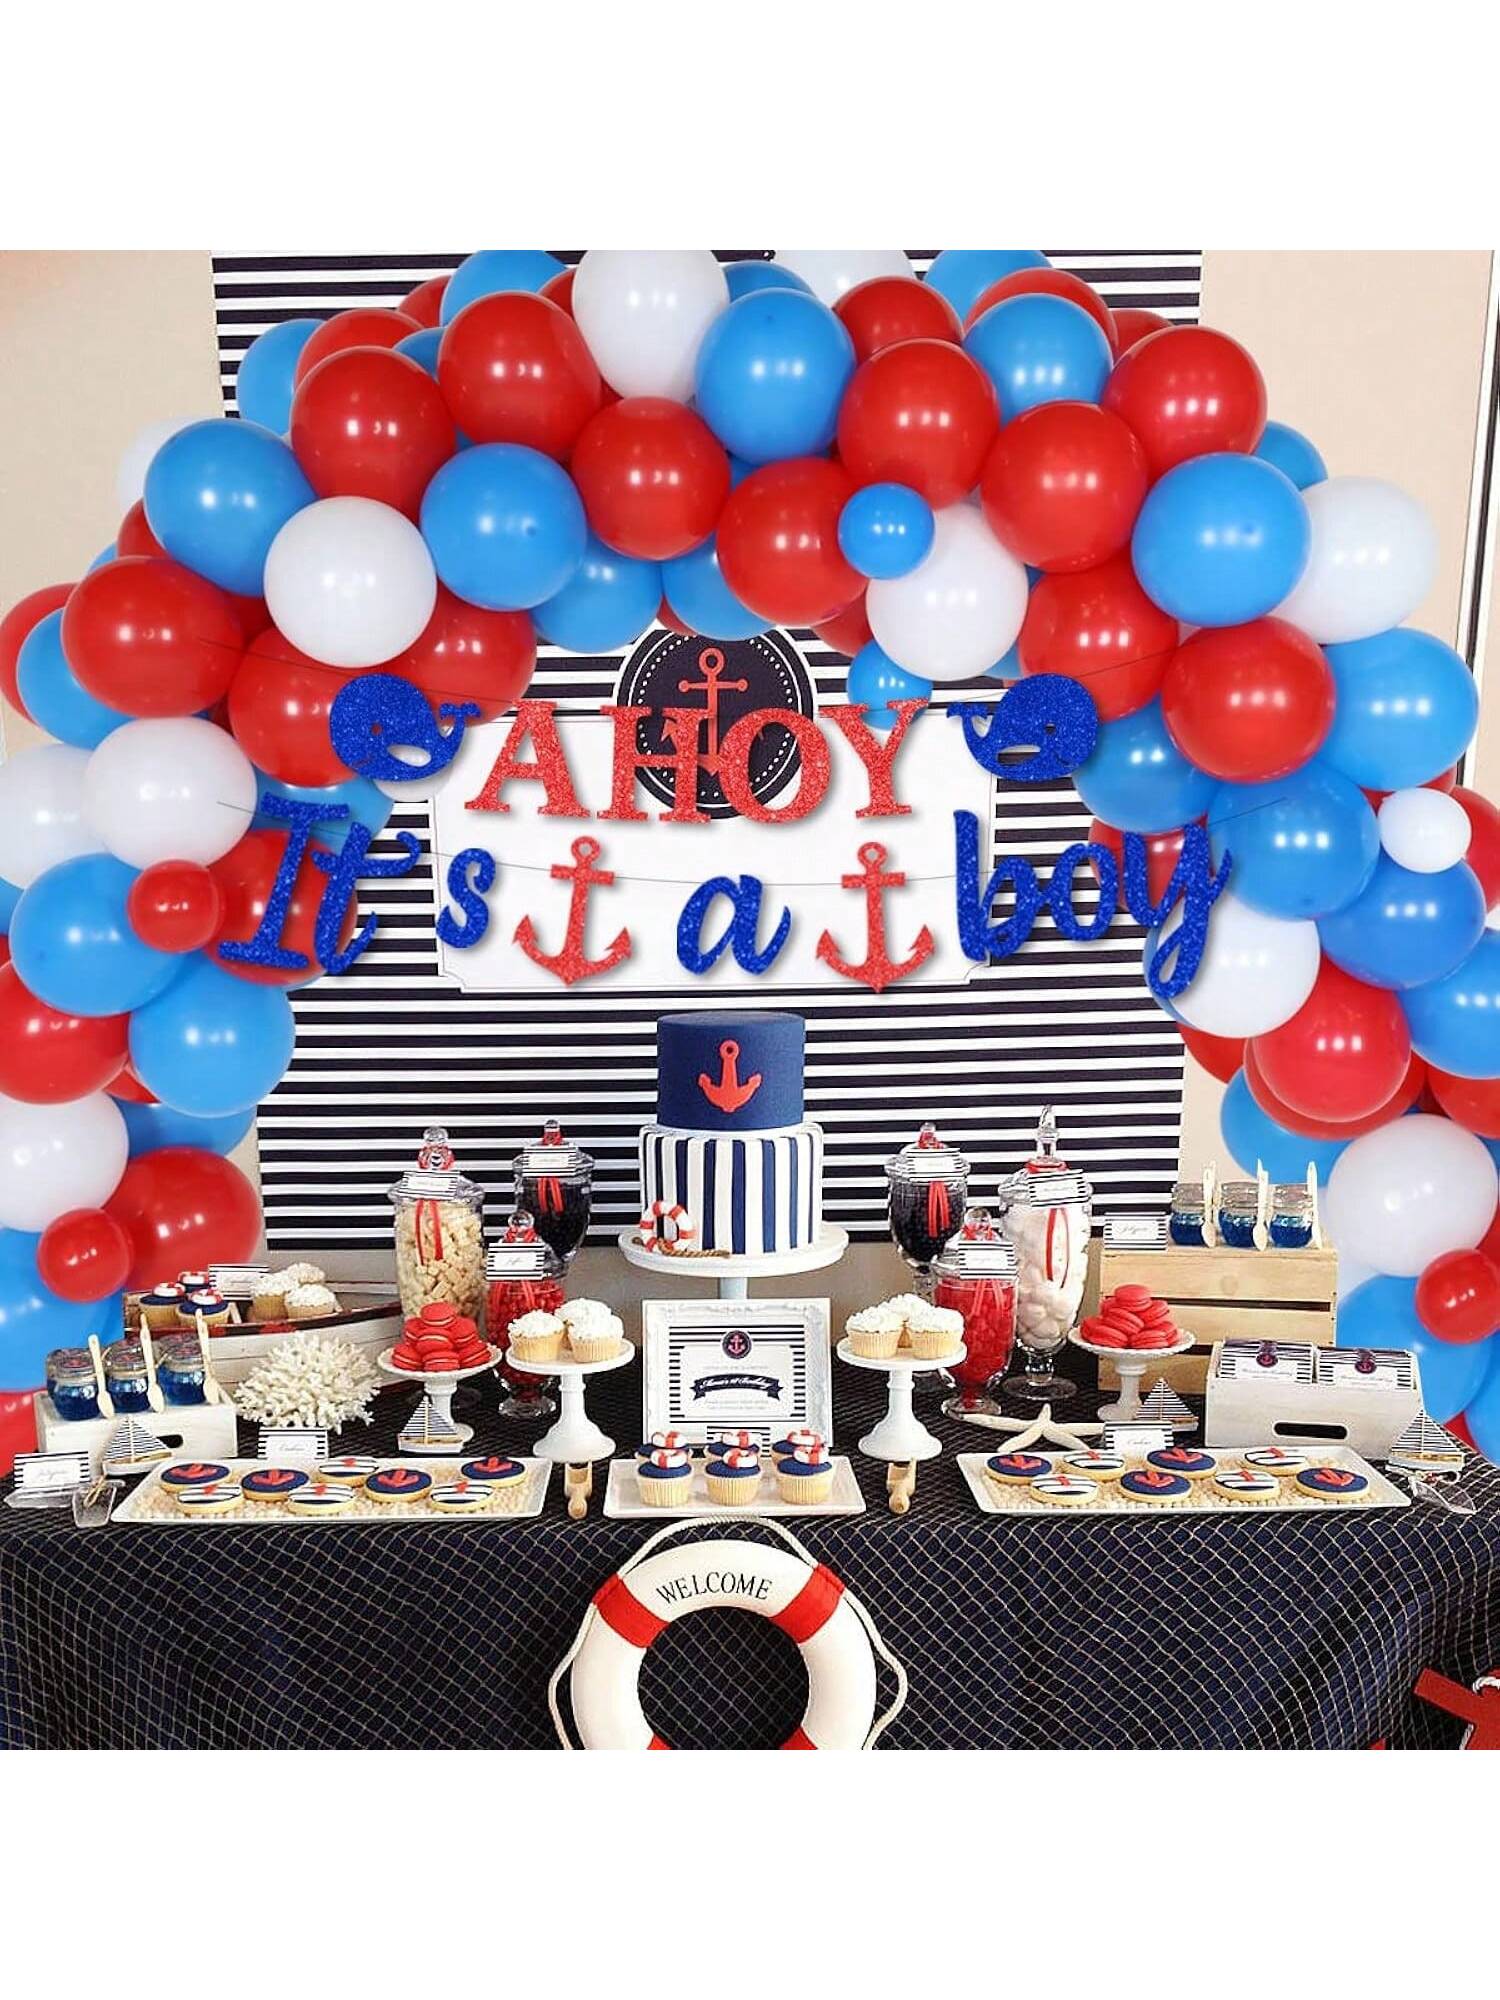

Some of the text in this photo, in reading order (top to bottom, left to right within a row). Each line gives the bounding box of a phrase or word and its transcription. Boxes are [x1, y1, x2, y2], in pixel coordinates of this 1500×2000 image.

[464, 699, 930, 824] AHOY
[677, 874, 791, 975] a
[953, 809, 1232, 1000] boy
[656, 1571, 773, 1604] WELCOME
